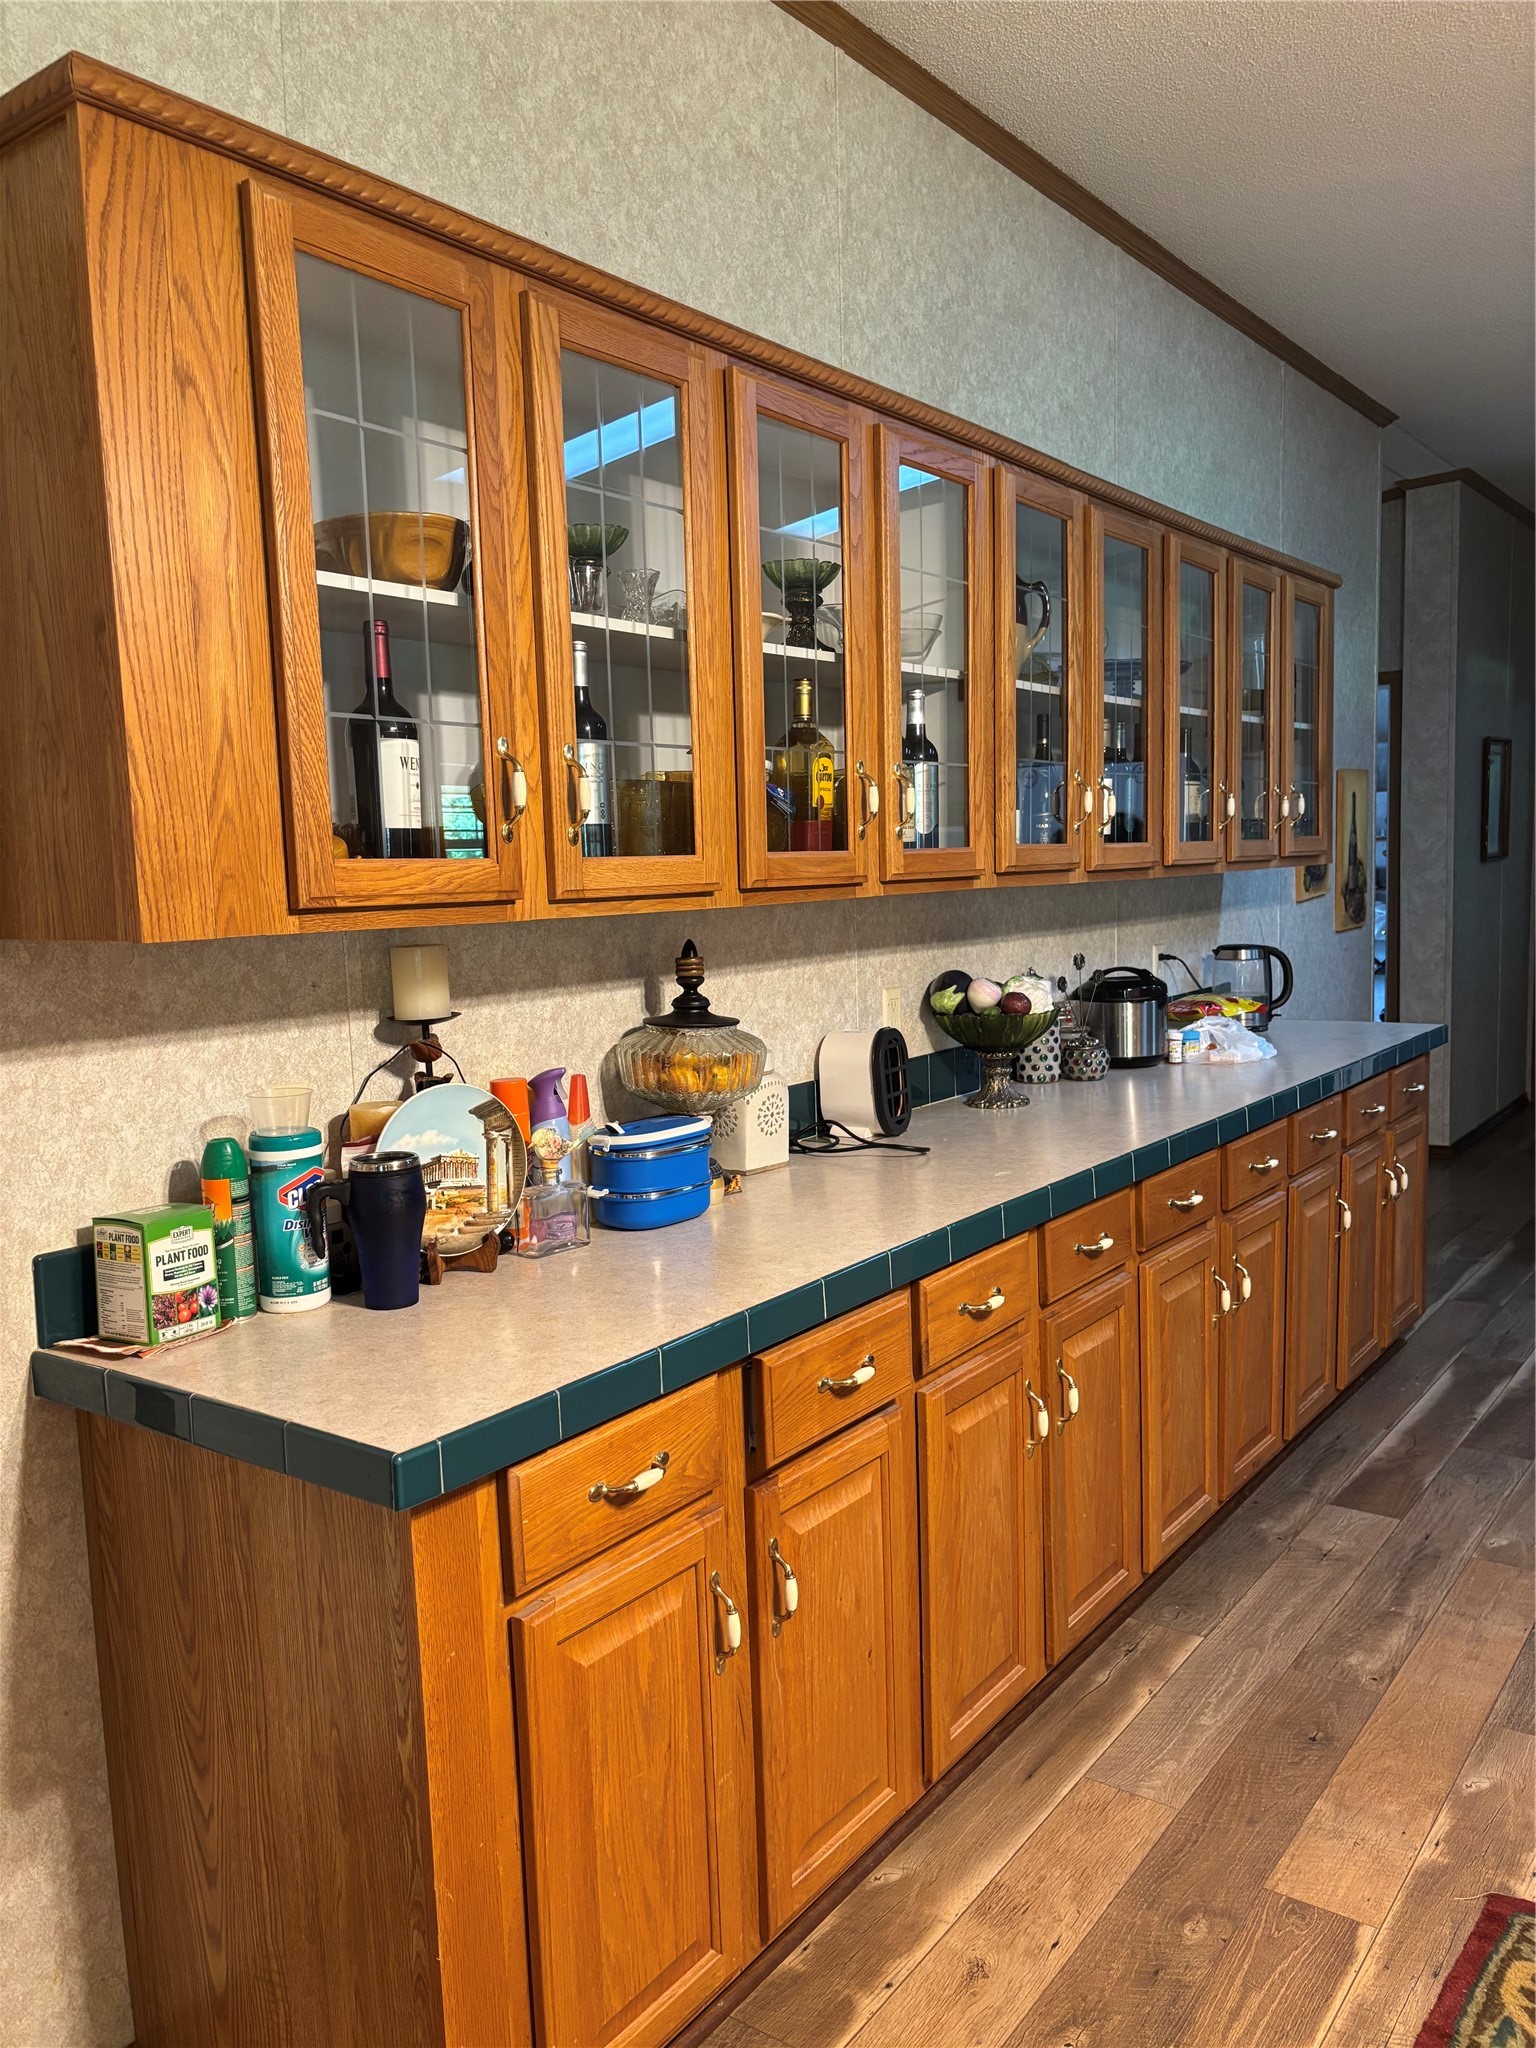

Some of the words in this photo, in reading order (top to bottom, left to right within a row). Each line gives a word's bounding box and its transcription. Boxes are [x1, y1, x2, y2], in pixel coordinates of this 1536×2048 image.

[108, 1232, 125, 1243] PLANT
[125, 1234, 140, 1245] FOOD
[172, 1228, 191, 1239] EXPERT
[155, 1249, 186, 1267] PLANT
[187, 1244, 209, 1259] FOOD
